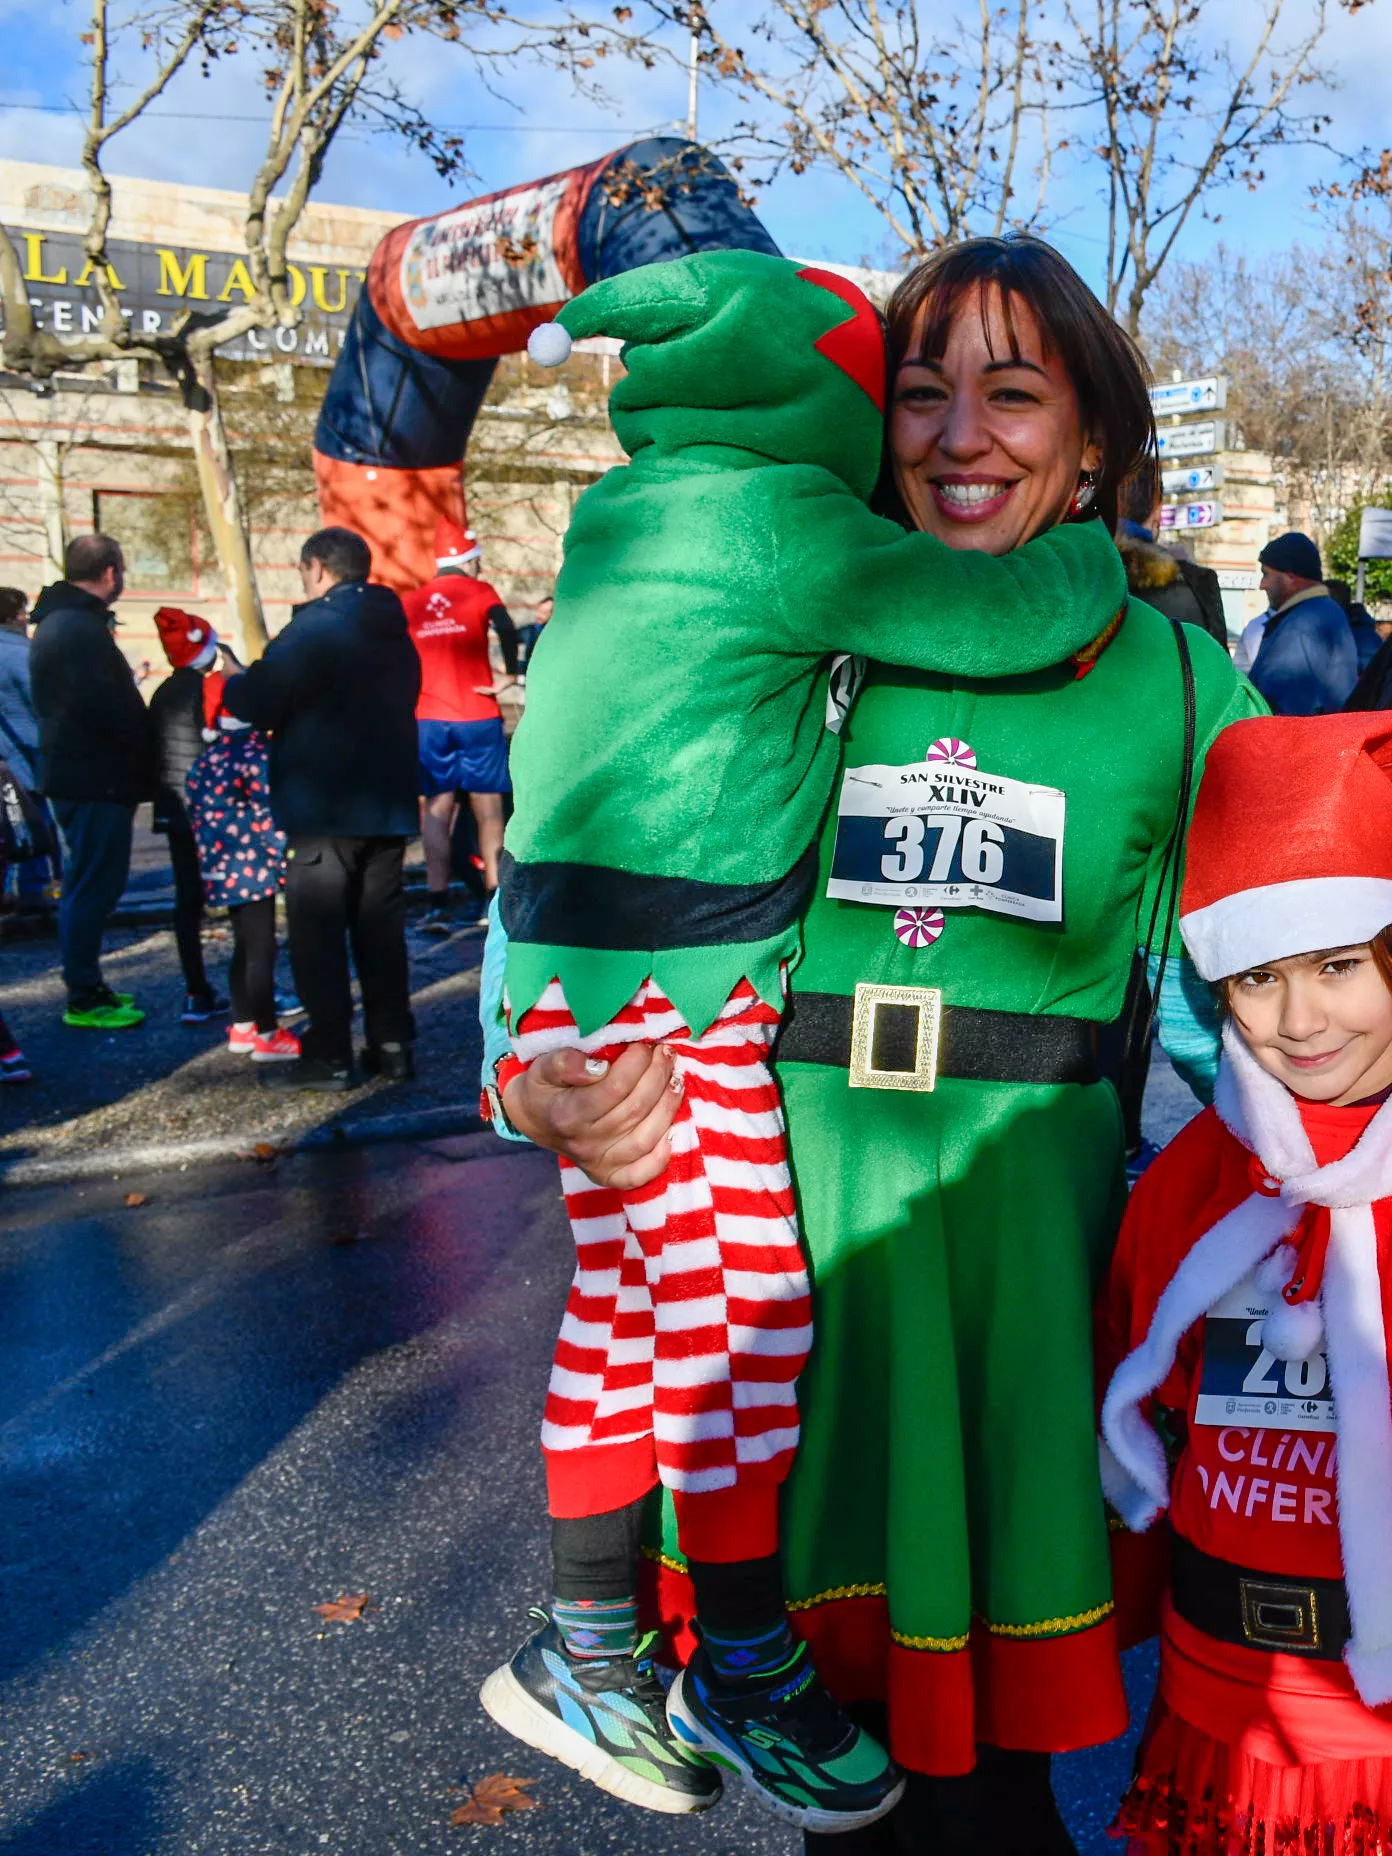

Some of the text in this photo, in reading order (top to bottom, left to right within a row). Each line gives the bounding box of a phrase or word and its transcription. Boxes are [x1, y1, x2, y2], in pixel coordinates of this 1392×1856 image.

[22, 232, 127, 290] LA
[900, 773, 1006, 796] SAN SILVESTRE
[928, 785, 987, 808] XLIV
[880, 814, 1005, 884] 376
